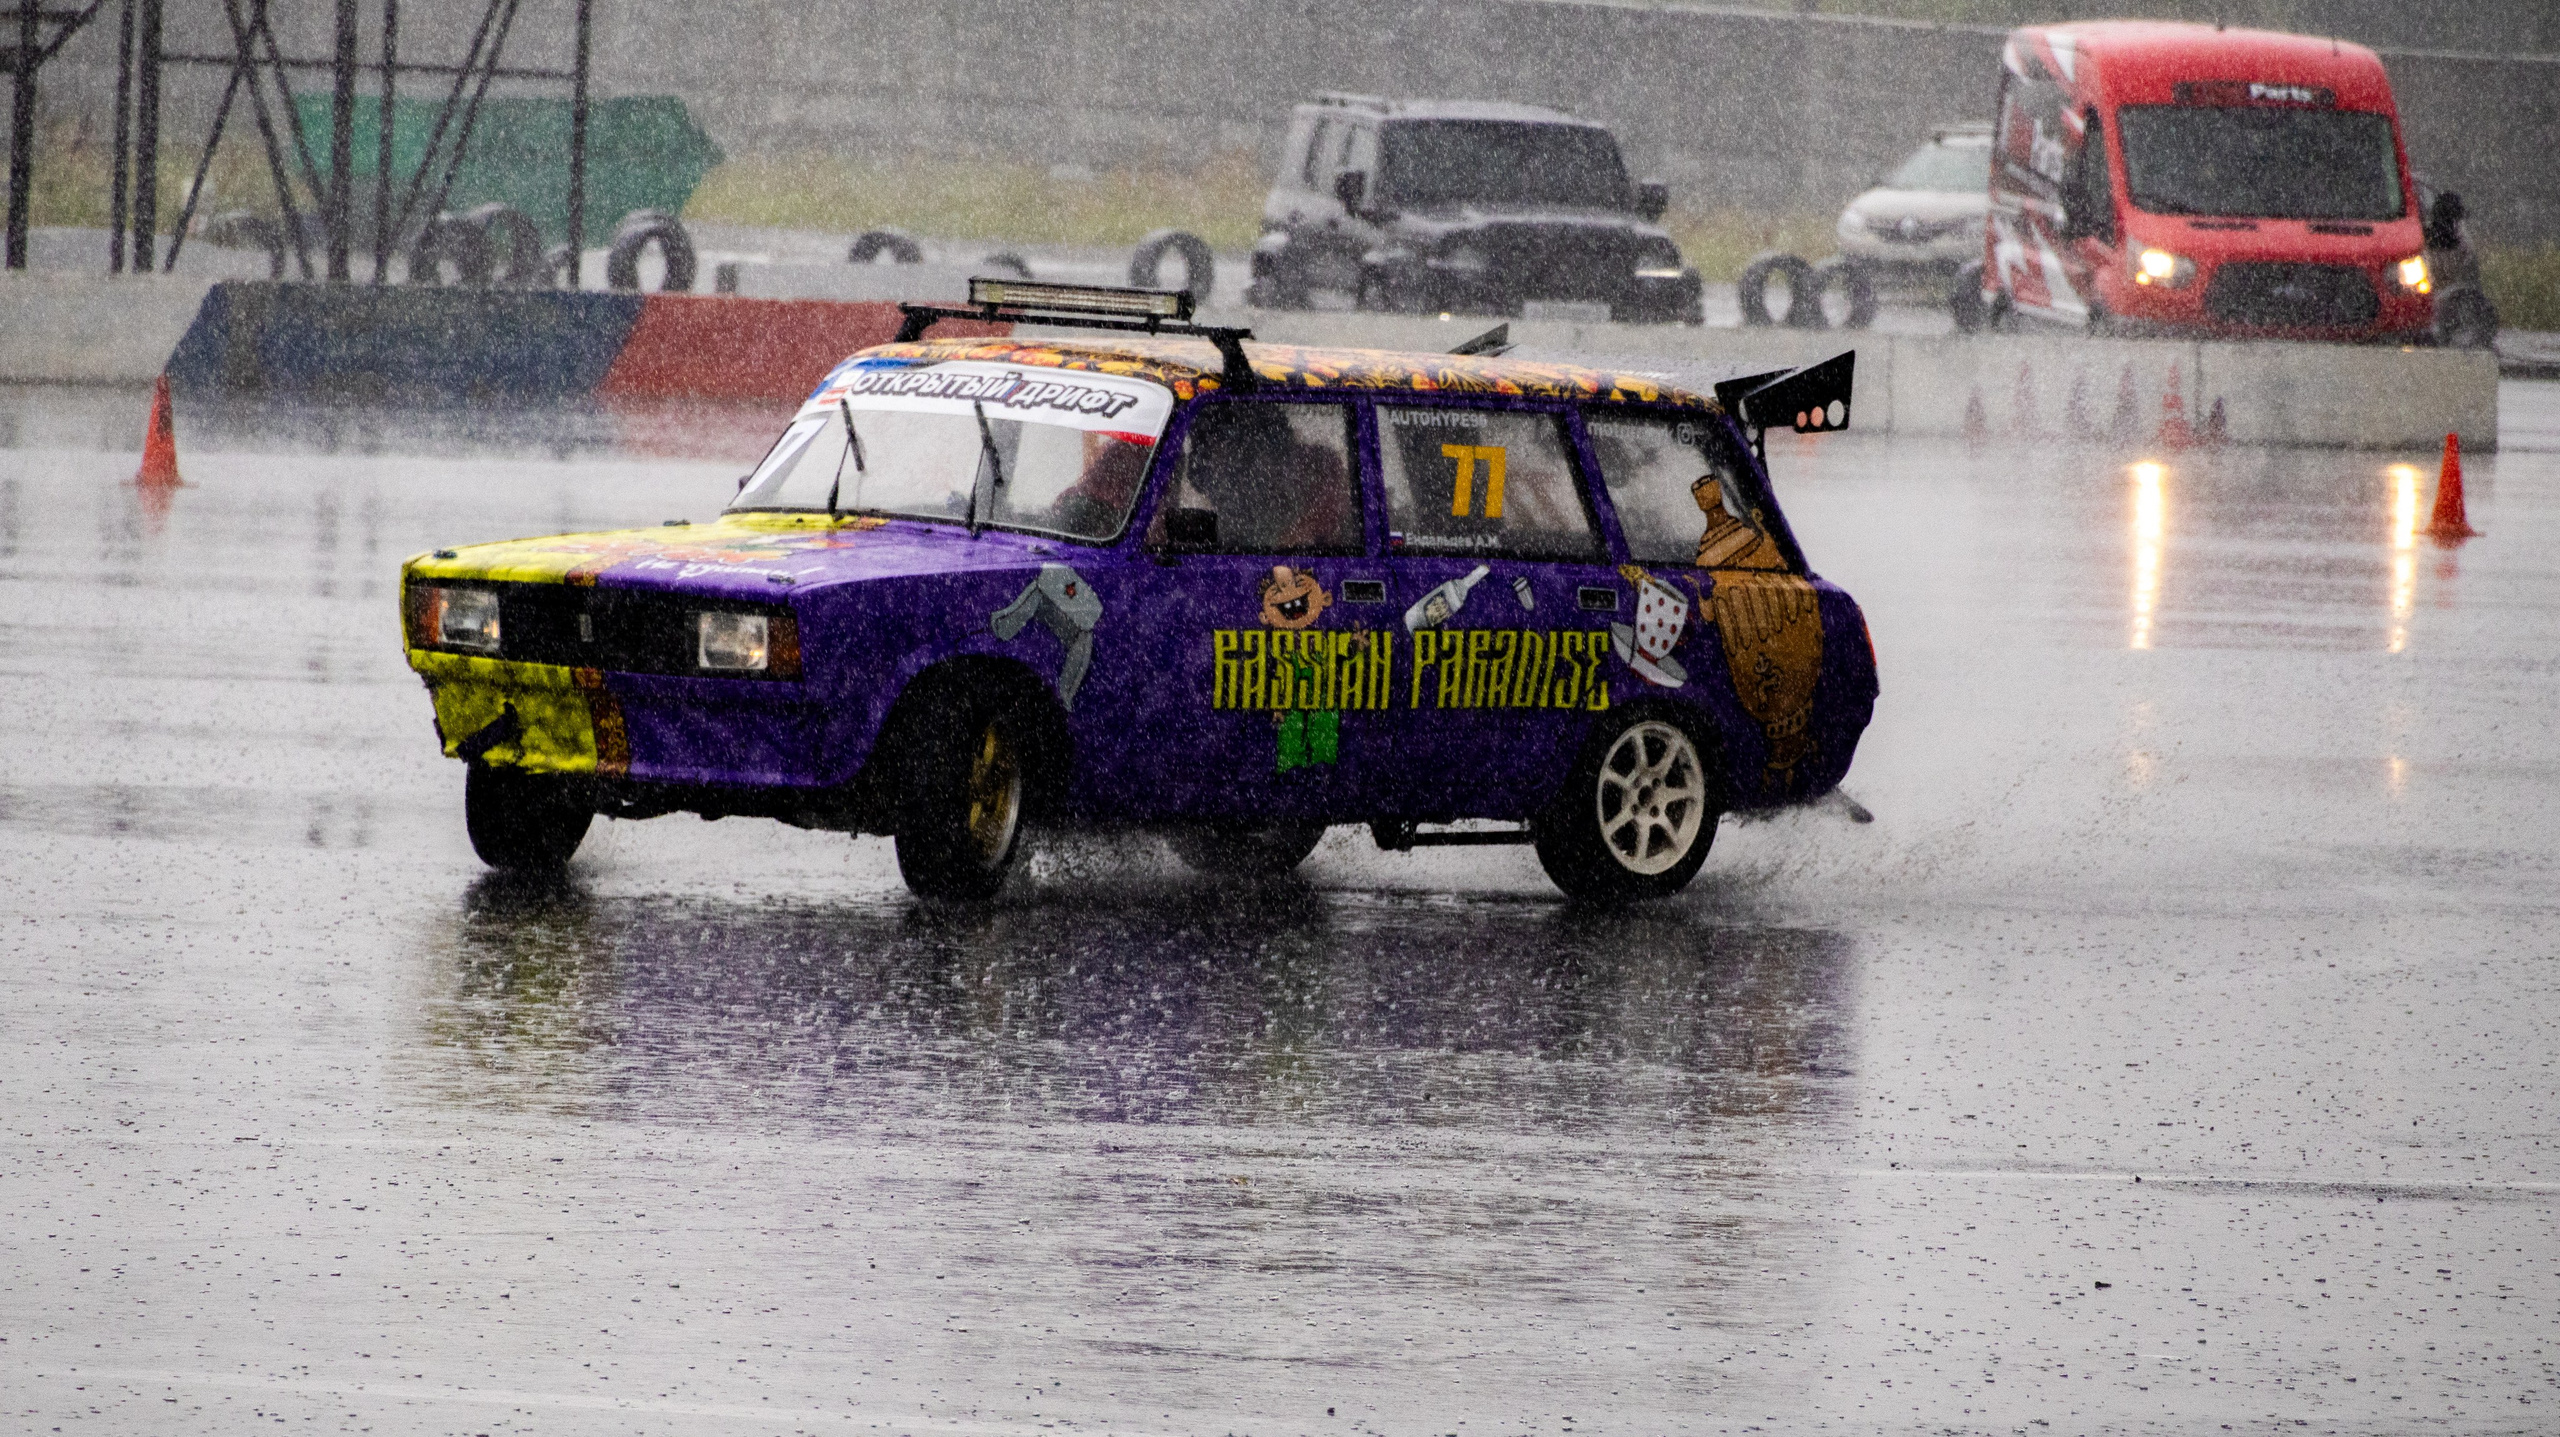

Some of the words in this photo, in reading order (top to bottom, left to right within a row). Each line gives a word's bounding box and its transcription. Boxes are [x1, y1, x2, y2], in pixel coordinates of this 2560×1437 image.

[853, 371, 1018, 402] ОТКРЫТЫЙ
[1008, 378, 1138, 418] ДРИФТ
[1441, 443, 1506, 518] 77
[1410, 629, 1610, 712] PARADISE
